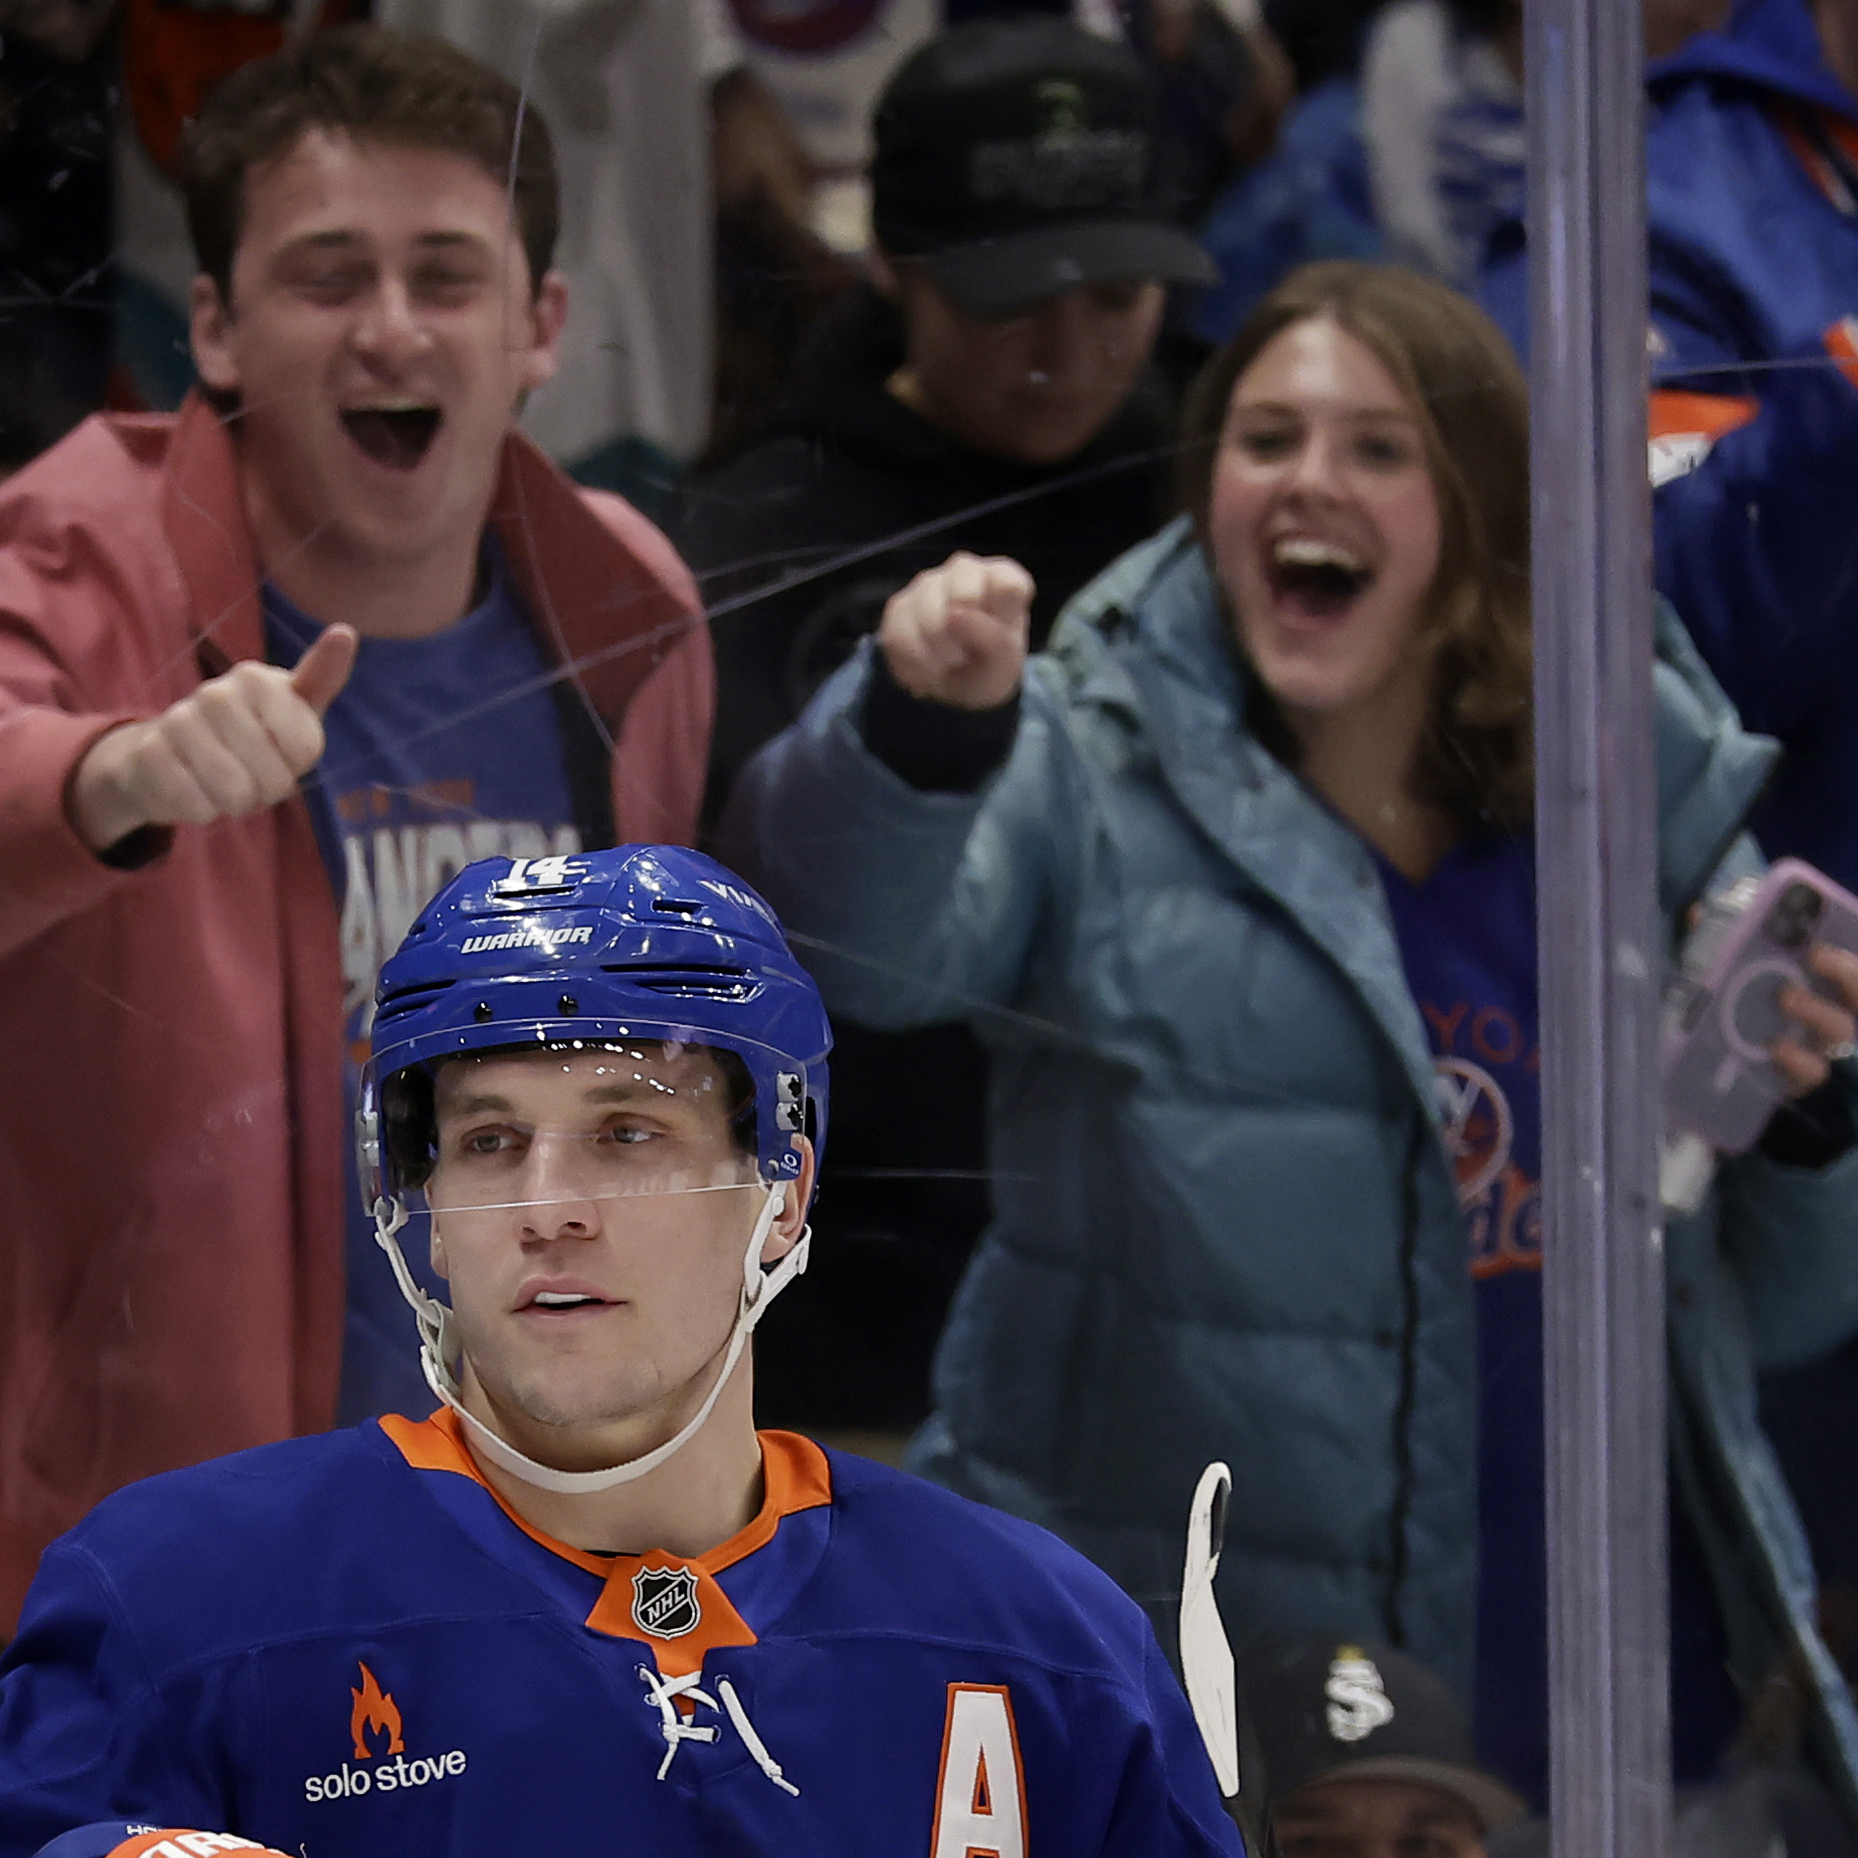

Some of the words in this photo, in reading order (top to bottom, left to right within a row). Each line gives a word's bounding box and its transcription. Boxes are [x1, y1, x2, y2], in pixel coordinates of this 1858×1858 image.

[506, 855, 569, 888] 14
[459, 926, 594, 955] WARRIOR
[645, 1585, 686, 1625] NHL
[304, 1762, 372, 1803] solo
[374, 1749, 468, 1792] stove
